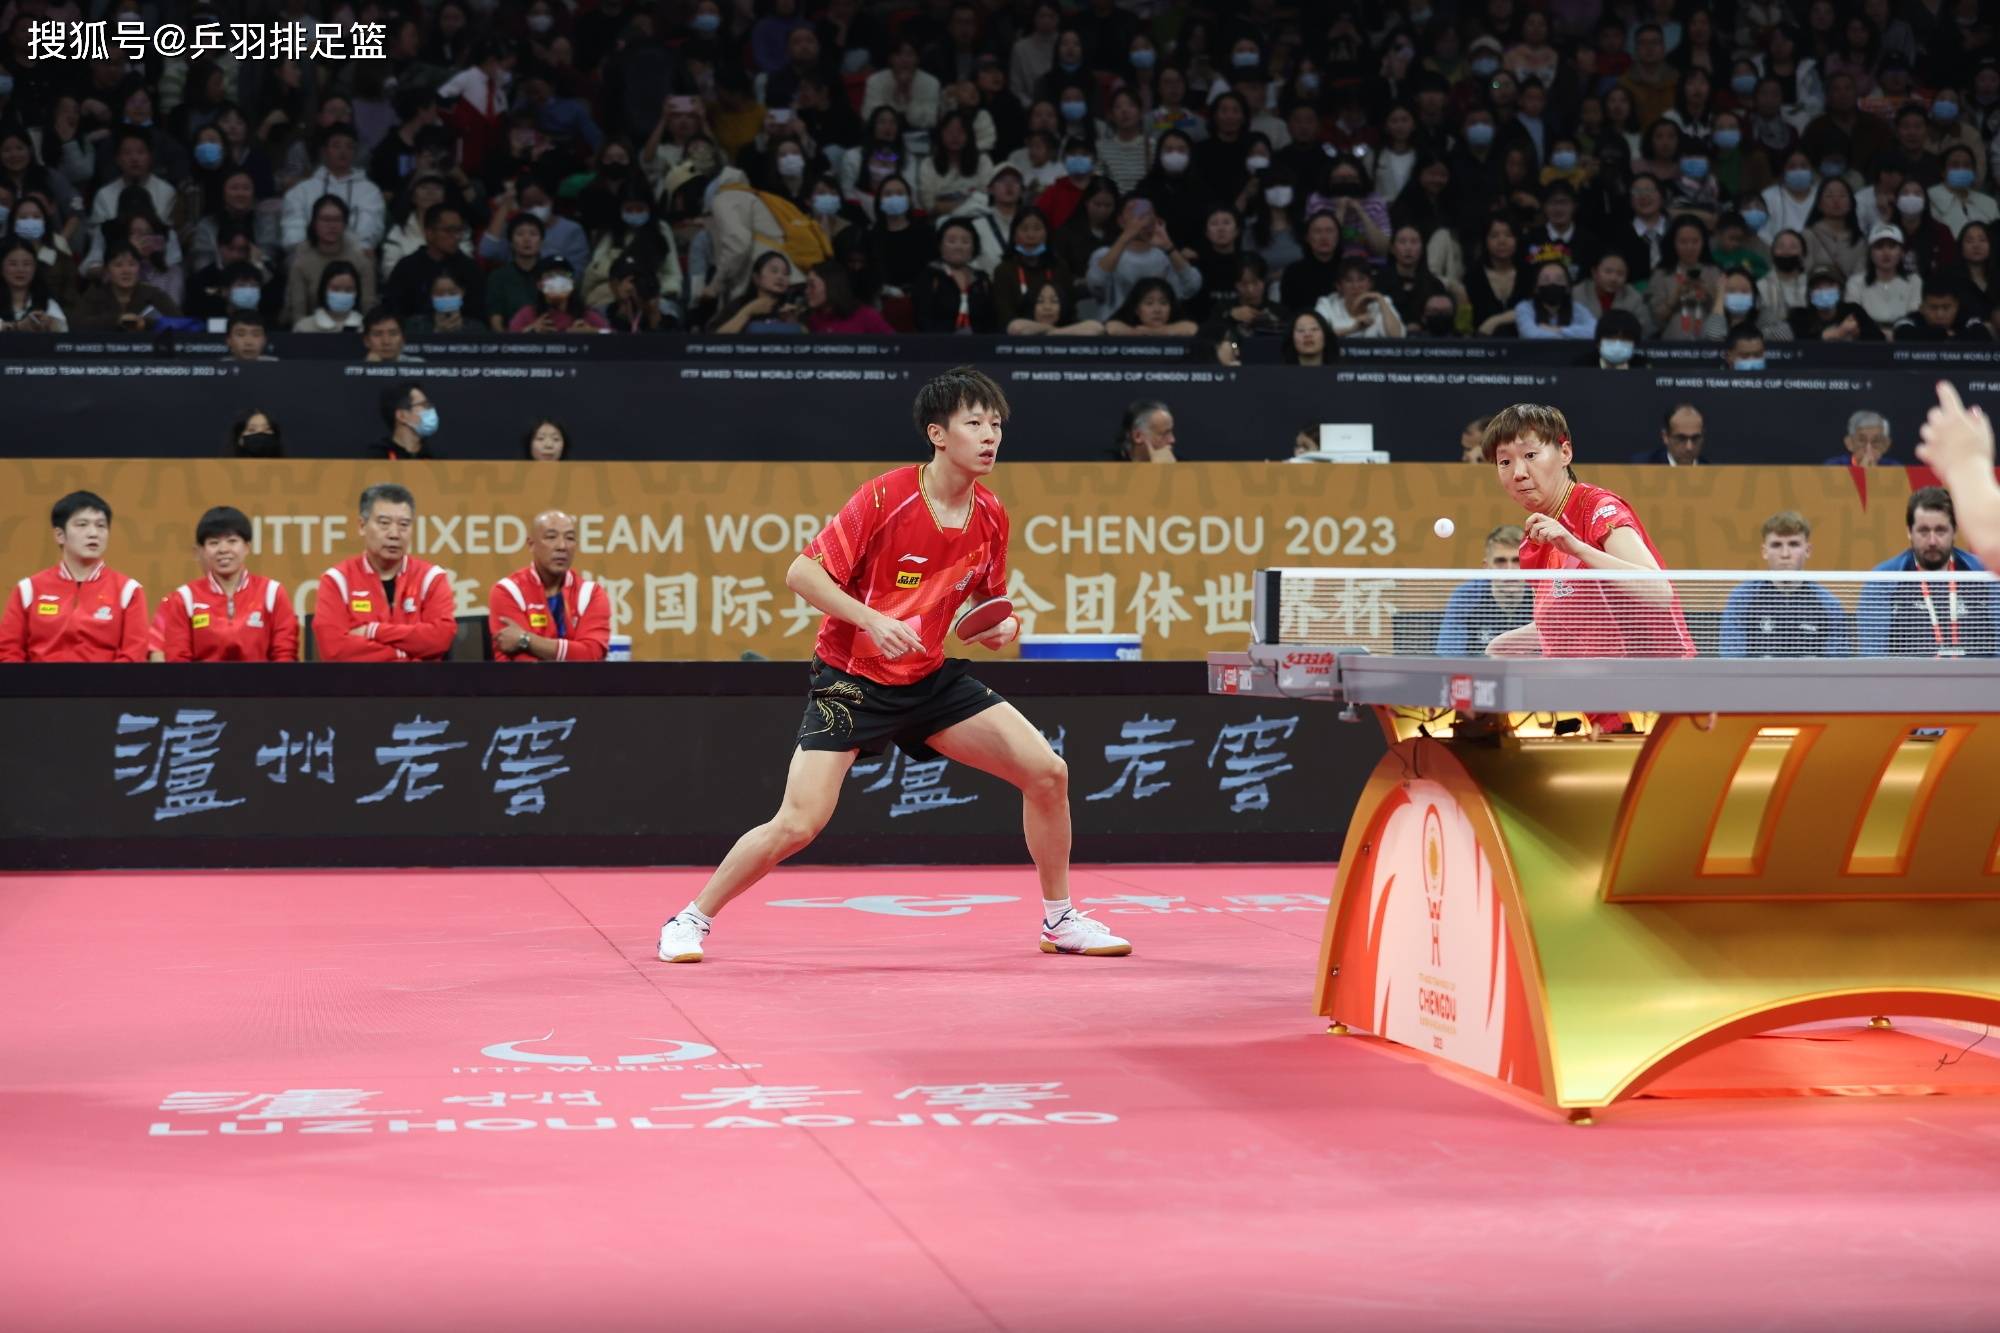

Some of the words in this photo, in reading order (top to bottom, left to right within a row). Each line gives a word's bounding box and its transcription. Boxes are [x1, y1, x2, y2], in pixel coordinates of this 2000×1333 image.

[251, 515, 348, 554] ITTF
[406, 514, 527, 554] IXED
[575, 514, 684, 554] EAM
[705, 513, 833, 554] WOR
[1025, 514, 1264, 555] CHENGDU
[1284, 516, 1397, 556] 2023
[452, 1066, 533, 1074] ITTF
[549, 1064, 685, 1073] WORLD
[695, 1062, 765, 1071] CUP
